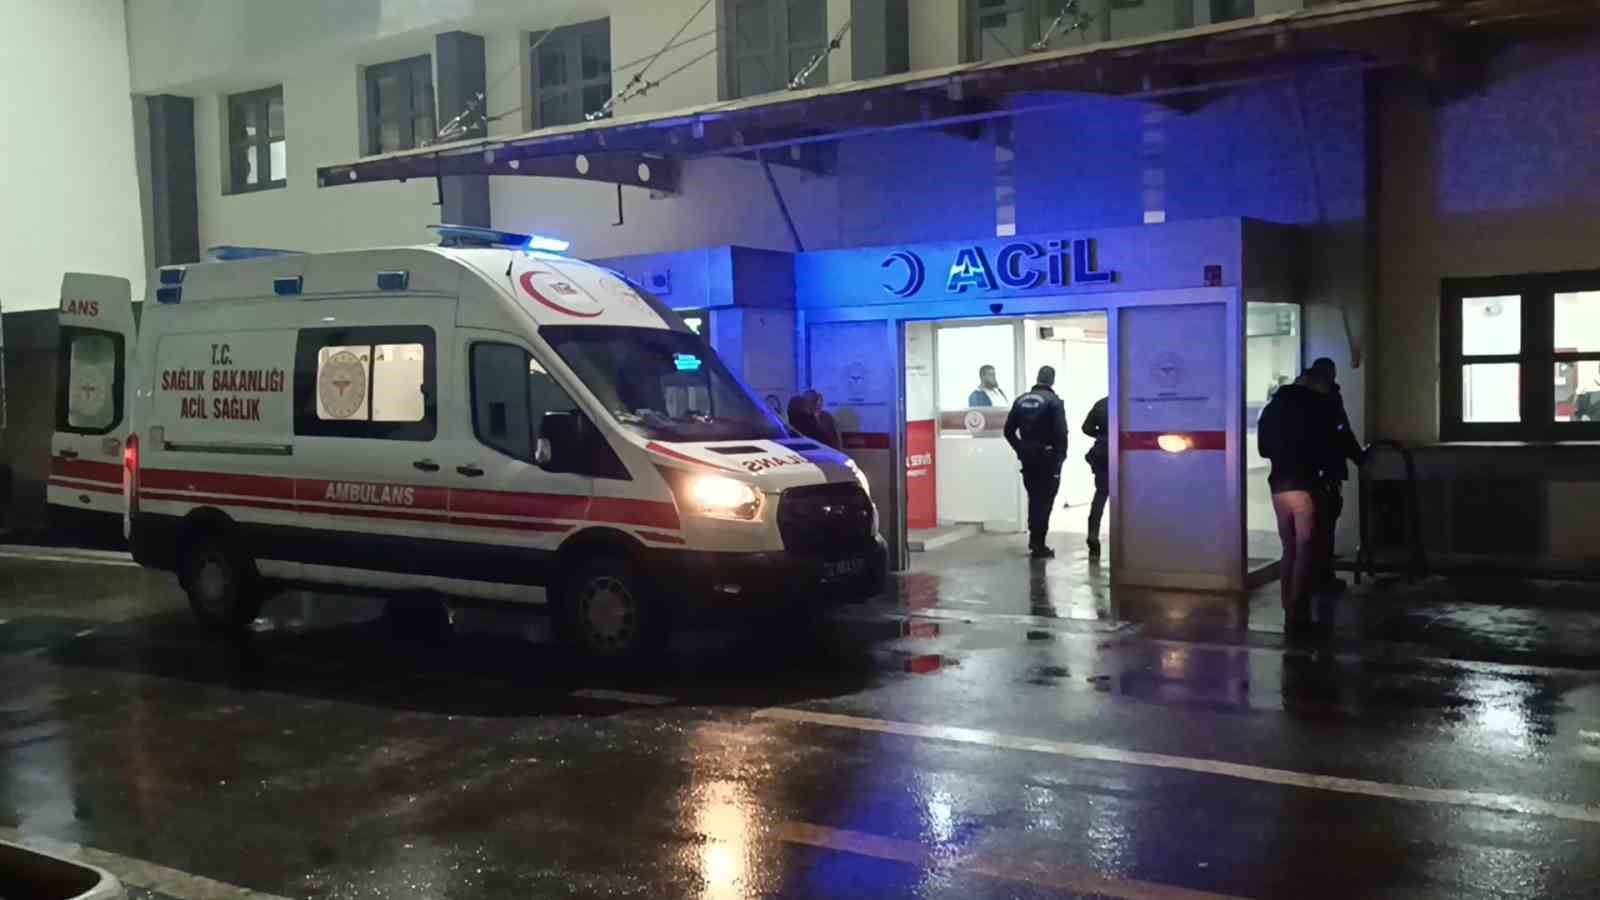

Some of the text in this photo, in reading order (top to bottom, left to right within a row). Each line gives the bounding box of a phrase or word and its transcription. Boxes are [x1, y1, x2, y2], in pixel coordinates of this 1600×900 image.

[211, 344, 232, 365] T.C.
[161, 367, 284, 393] SAĞLIK BAKANLIĞI
[180, 395, 260, 421] ACİL SAĞLIK
[325, 481, 415, 506] AMBULANS
